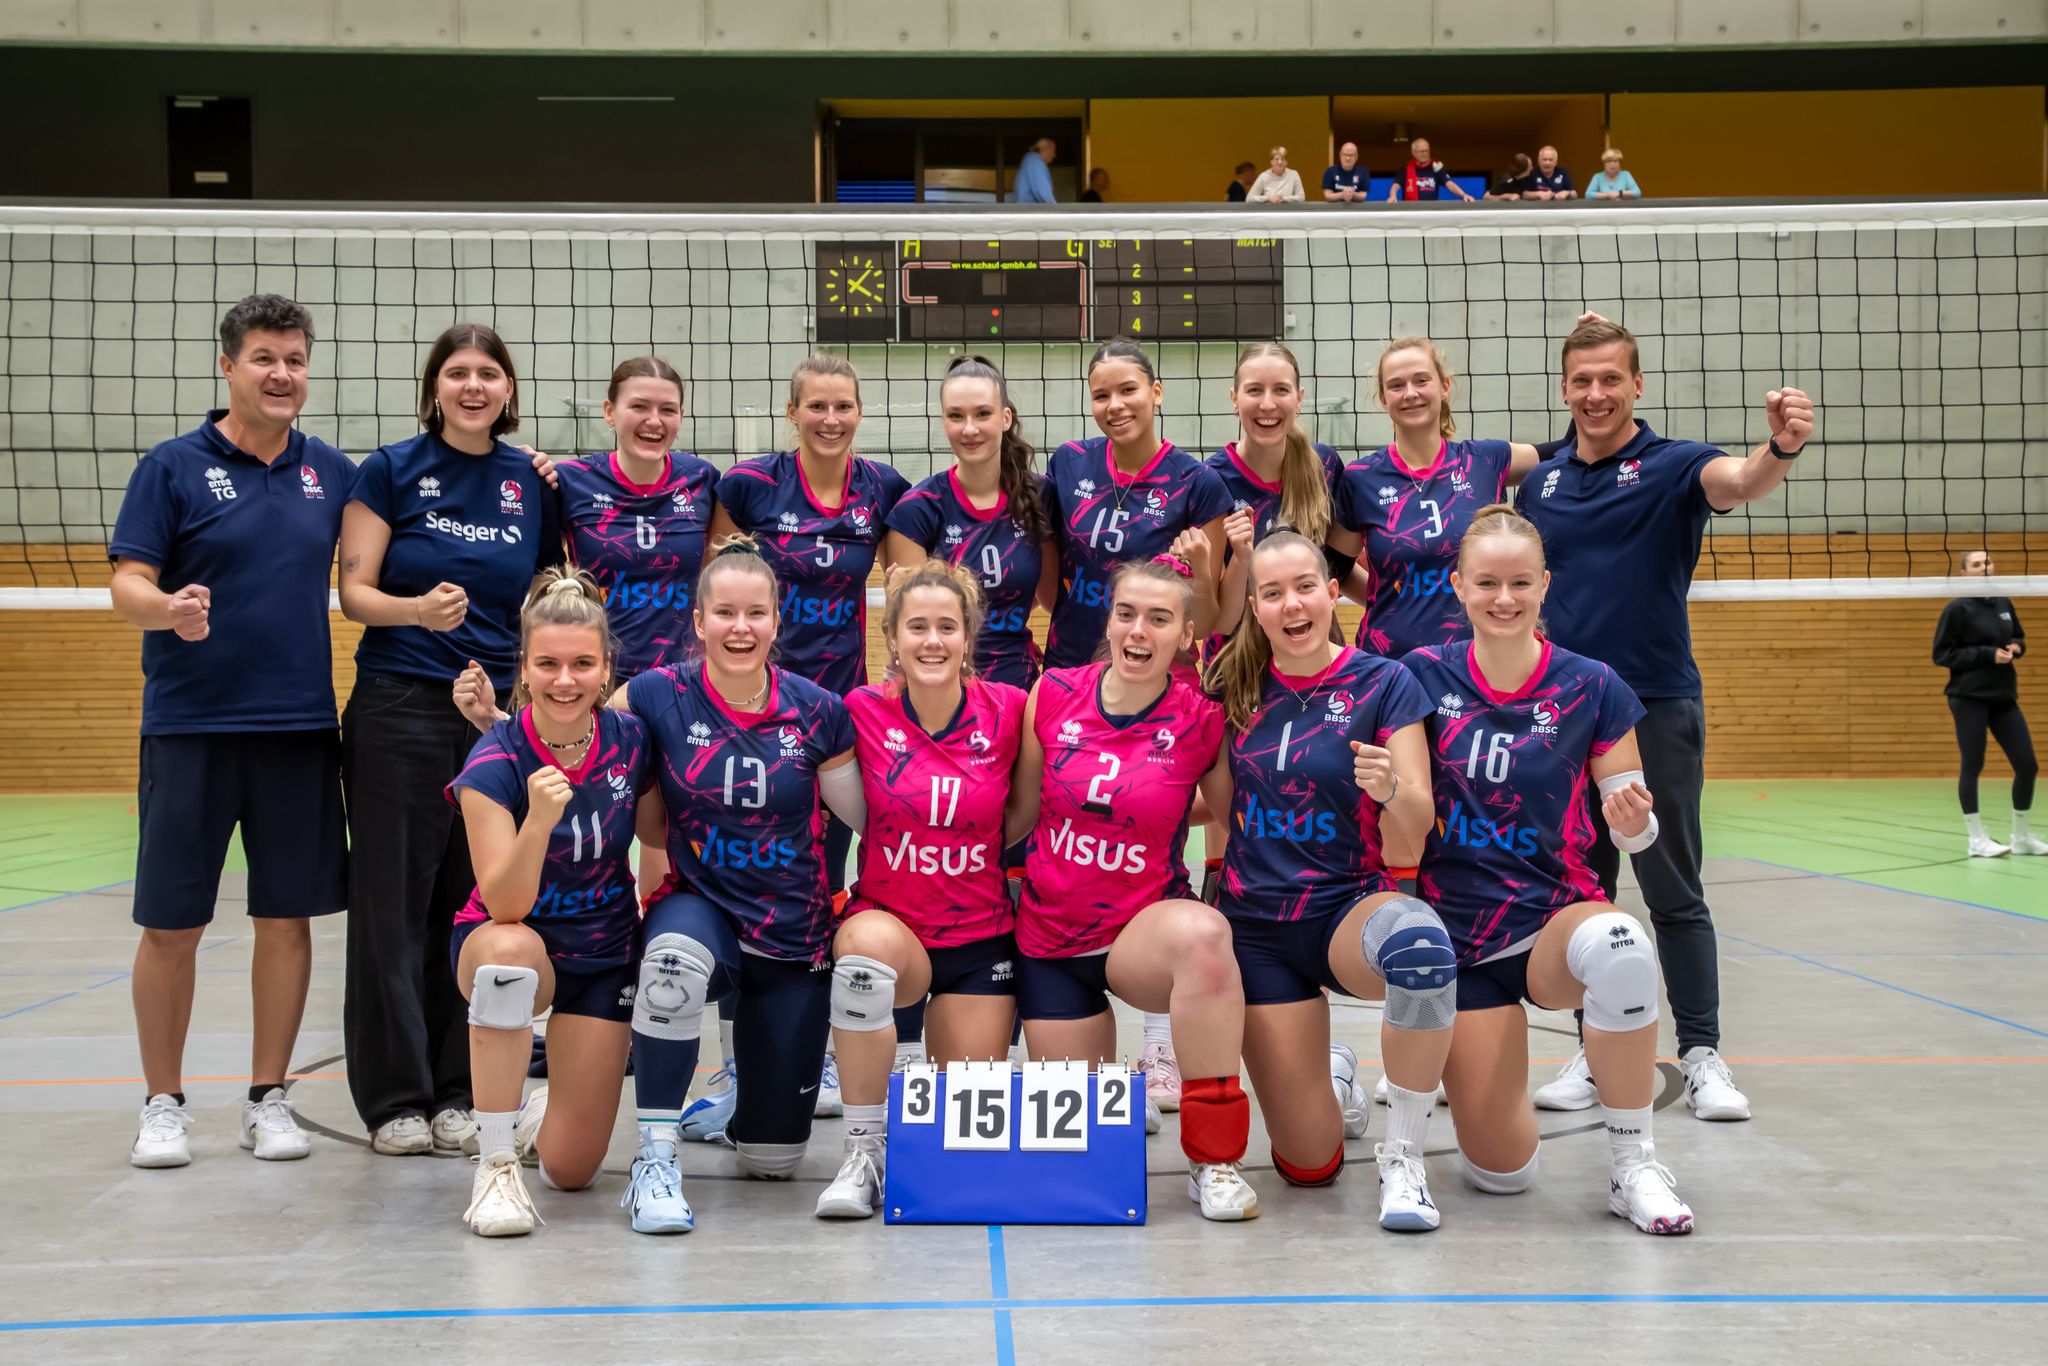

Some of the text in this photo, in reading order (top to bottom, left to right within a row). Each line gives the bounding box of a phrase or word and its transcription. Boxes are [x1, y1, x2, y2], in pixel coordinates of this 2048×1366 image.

[1132, 264, 1141, 278] 2
[1132, 290, 1141, 305] 3
[1132, 317, 1141, 332] 4
[211, 486, 237, 500] TG
[1074, 488, 1093, 500] errea
[1541, 486, 1556, 499] RP
[500, 499, 523, 509] BBSC
[1379, 496, 1399, 505] errea
[673, 505, 695, 513] BBSC
[1143, 507, 1166, 517] BBSC
[425, 510, 498, 543] Seeger
[1419, 500, 1443, 539] 3
[636, 515, 656, 549] 6
[777, 523, 799, 533] errea
[1089, 507, 1130, 553] 15
[815, 536, 834, 567] 5
[981, 544, 1002, 588] 9
[600, 571, 689, 609] VISUS
[1325, 713, 1351, 723] BBSC
[1438, 706, 1462, 719] errea
[1531, 725, 1558, 734] BBSC
[686, 734, 710, 747] errea
[1057, 732, 1079, 744] errea
[1276, 720, 1293, 771] 1
[780, 748, 805, 757] BBSC
[883, 740, 907, 752] errea
[1466, 729, 1515, 783] 16
[723, 755, 767, 808] 13
[1087, 752, 1121, 805] 2
[928, 775, 962, 827] 17
[1236, 794, 1337, 843] VISUS
[571, 810, 603, 863] 11
[1436, 801, 1539, 857] VISUS
[689, 825, 798, 869] VISUS
[883, 831, 988, 876] VISUS
[1049, 818, 1147, 874] VISUS
[1611, 938, 1635, 949] errea
[659, 967, 680, 976] errea
[849, 981, 873, 991] errea
[907, 1077, 1126, 1139] 3 15 12 2
